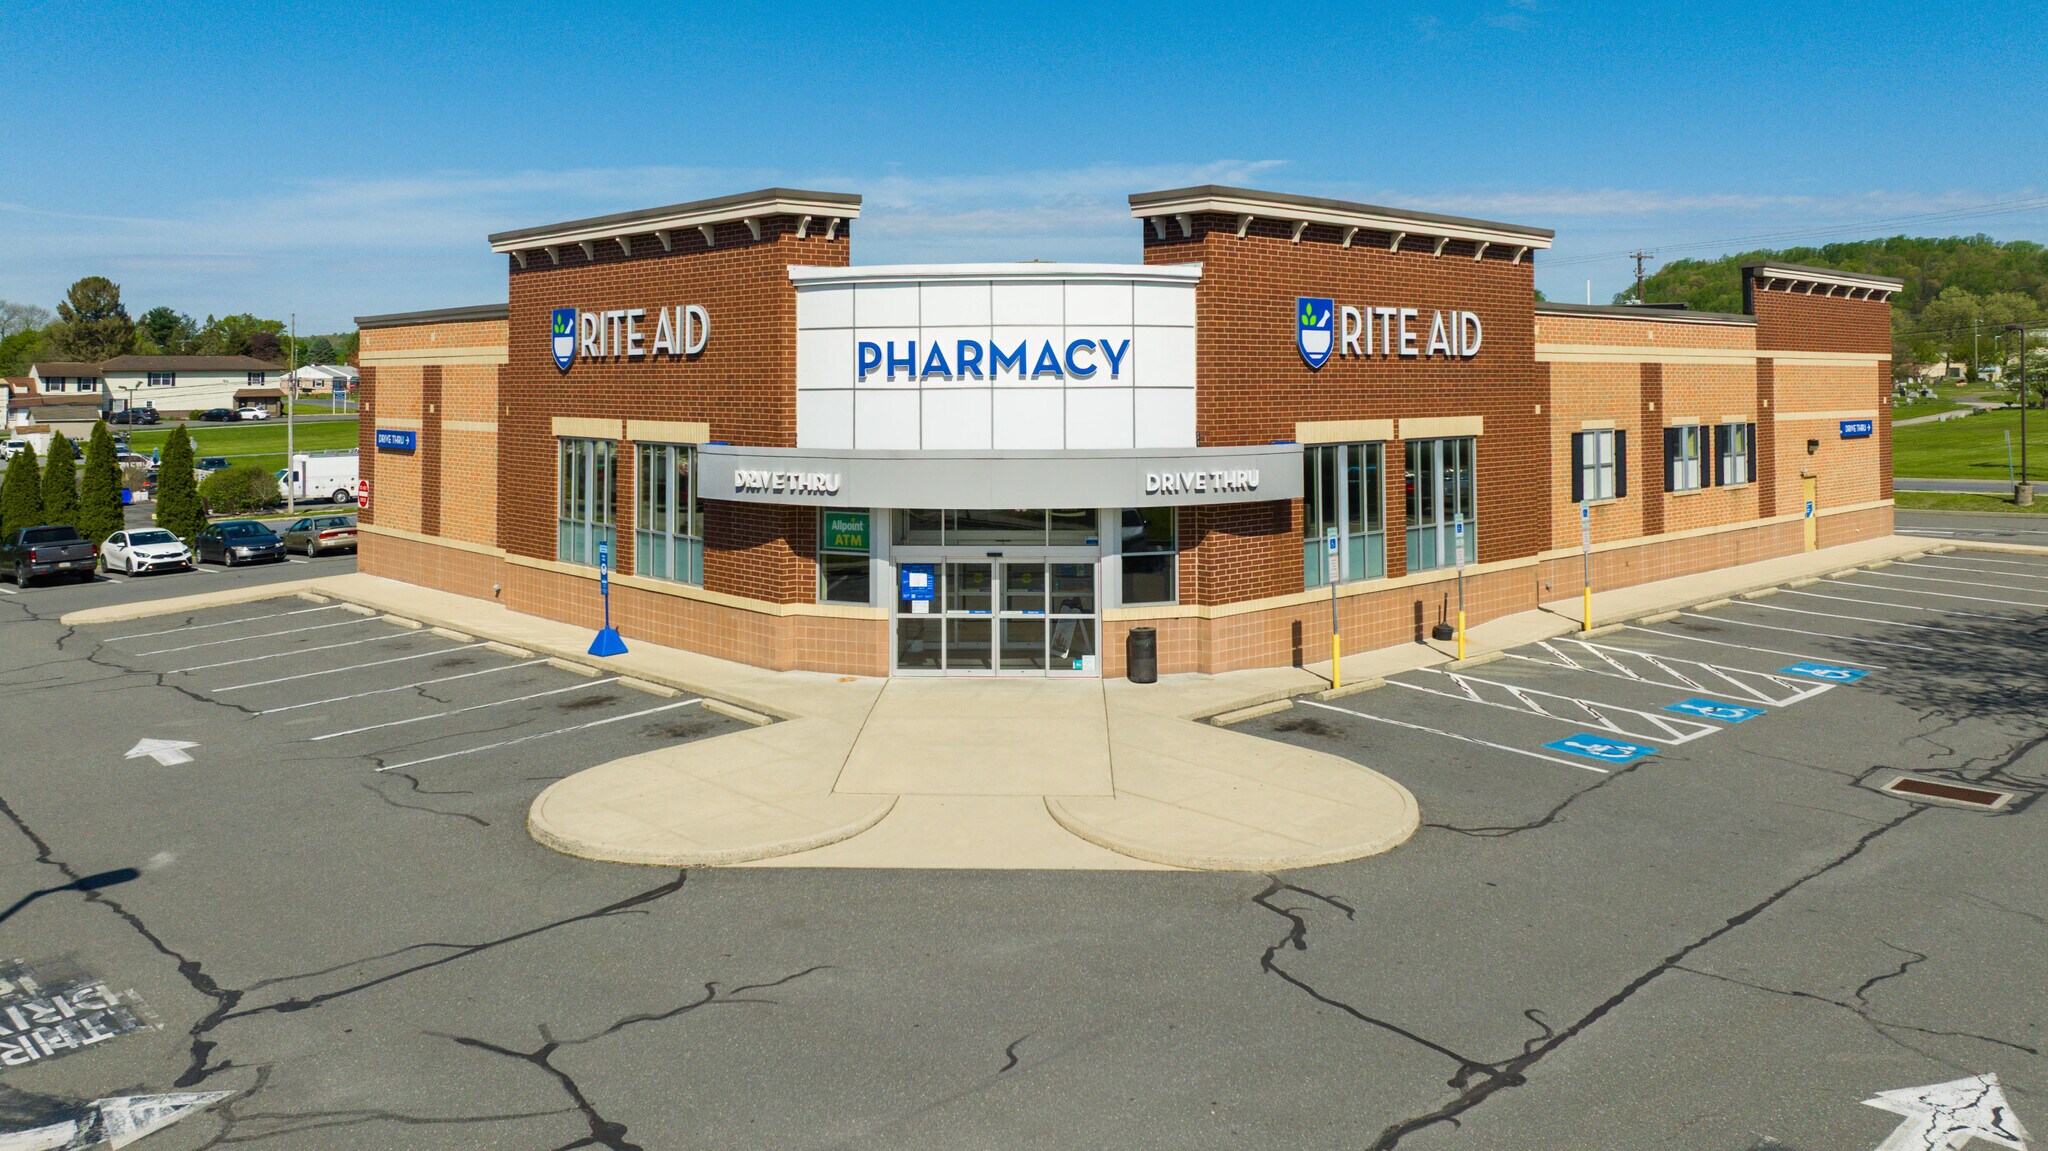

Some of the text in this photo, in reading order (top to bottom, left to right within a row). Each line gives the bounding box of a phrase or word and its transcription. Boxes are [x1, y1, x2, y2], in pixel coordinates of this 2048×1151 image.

[581, 304, 711, 357] RITE AID
[1340, 306, 1482, 356] RITE AID
[858, 338, 1131, 380] PHARMACY
[378, 433, 405, 445] DRIVE THRU
[734, 470, 841, 492] DRIVE THRU
[1145, 469, 1260, 493] DRIVE THRU
[832, 520, 864, 532] Allpoint
[835, 534, 863, 546] ATM
